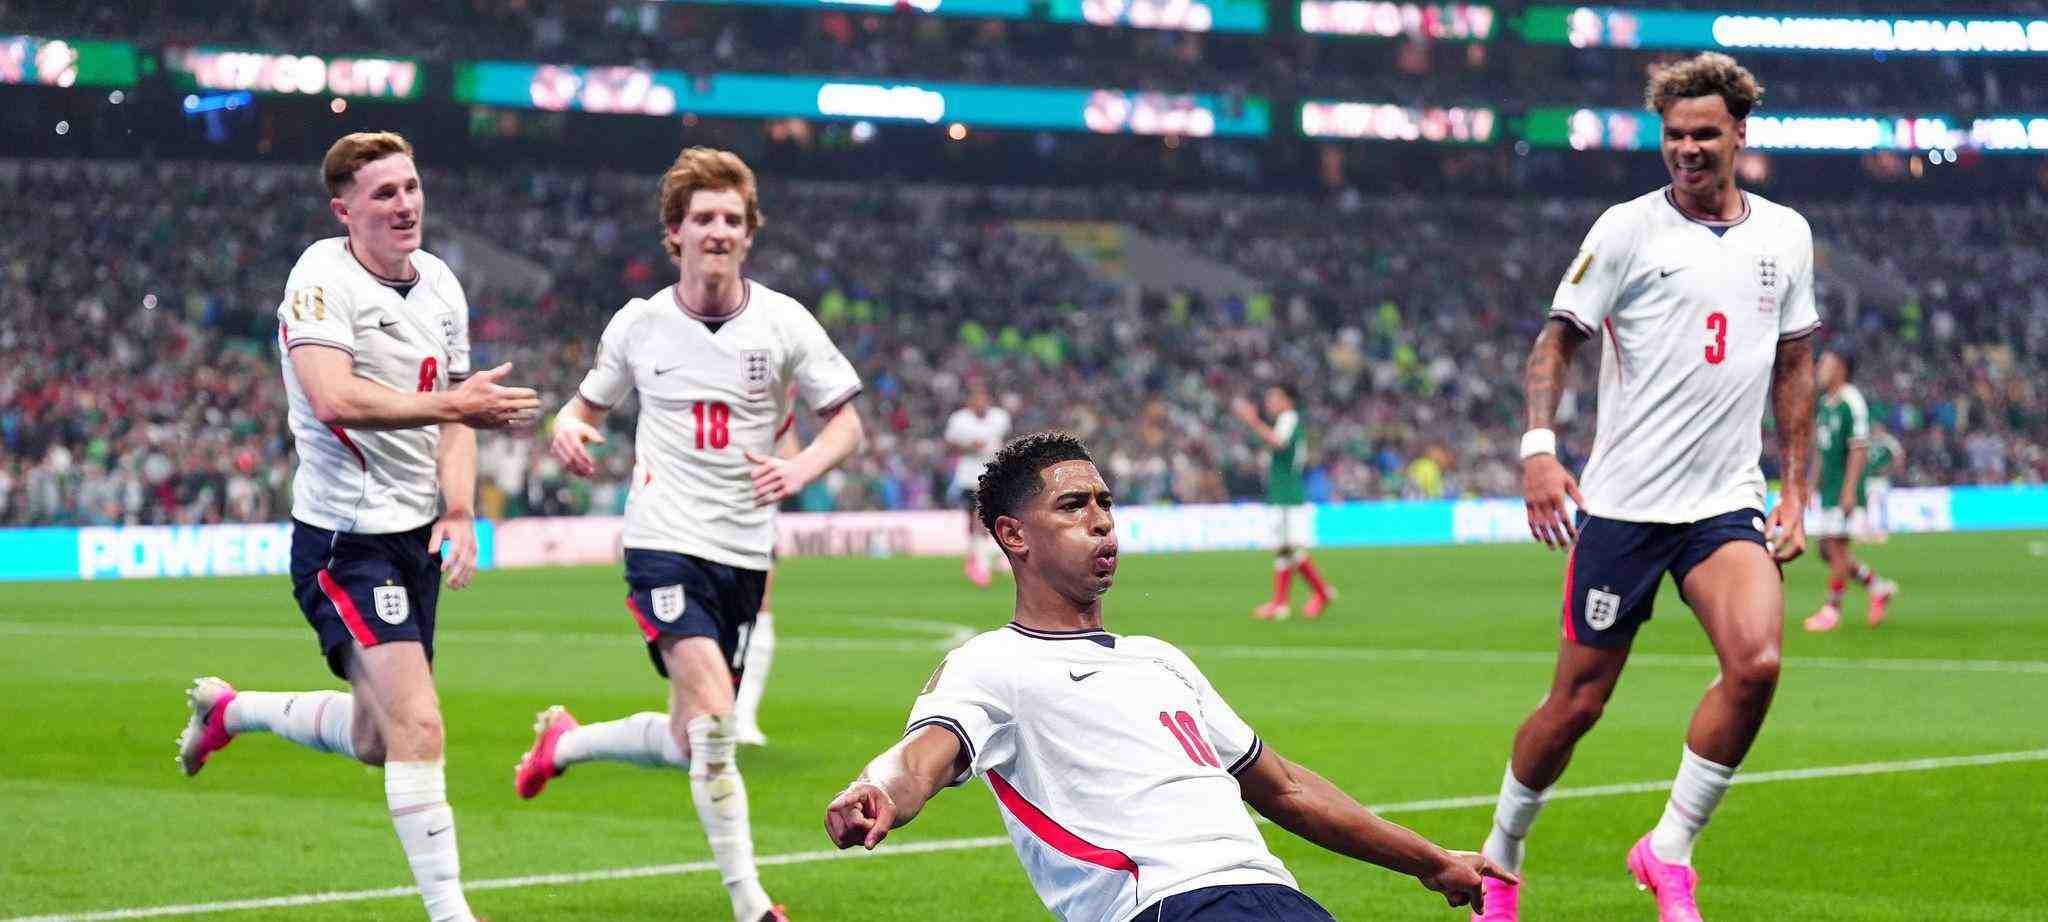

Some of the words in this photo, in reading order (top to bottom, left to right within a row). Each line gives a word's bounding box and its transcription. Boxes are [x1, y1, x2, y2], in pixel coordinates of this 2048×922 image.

[1705, 312, 1727, 365] 3
[692, 400, 729, 450] 18
[1159, 710, 1221, 769] 10
